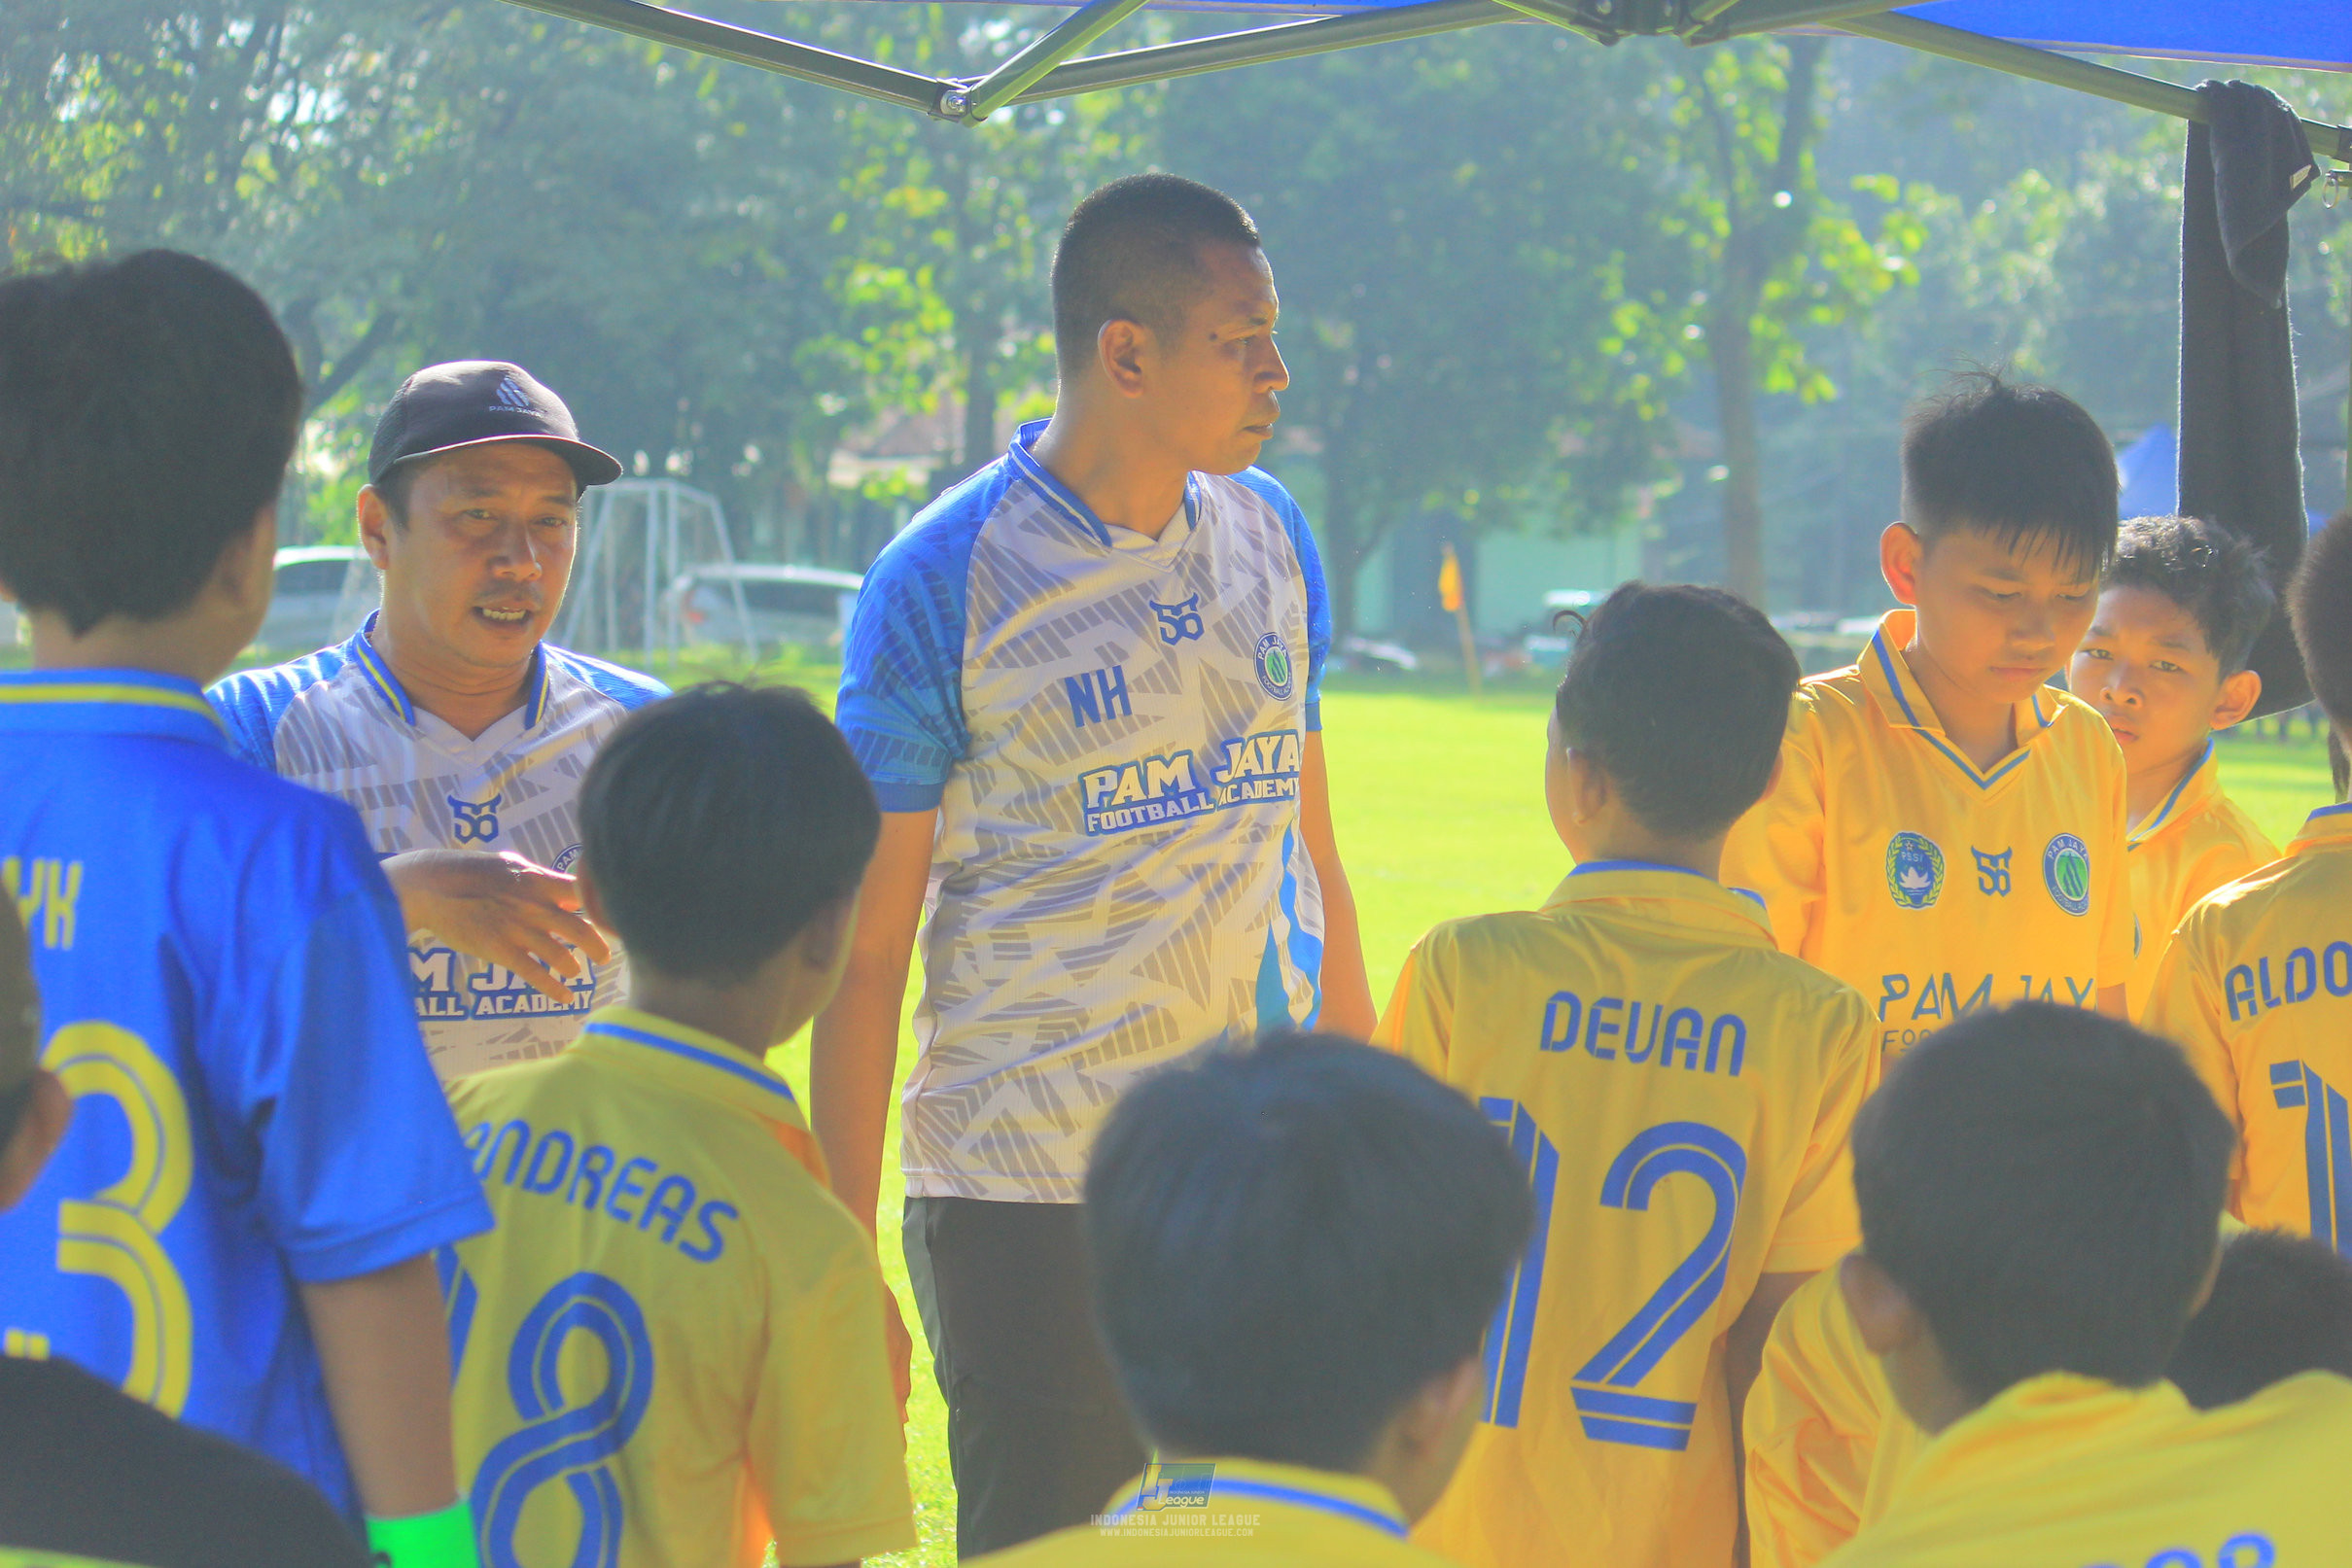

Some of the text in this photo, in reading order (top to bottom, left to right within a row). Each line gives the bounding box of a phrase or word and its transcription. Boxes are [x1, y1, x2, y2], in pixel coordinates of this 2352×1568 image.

[1257, 638, 1271, 660] PAM
[1065, 665, 1133, 728] NH
[1082, 734, 1300, 809] PAM JAYA
[1087, 777, 1300, 833] FOOTBALL ACADEMY
[1878, 973, 1993, 1023] PAM
[2225, 940, 2352, 1022] ALDO
[4, 1021, 192, 1420] 3
